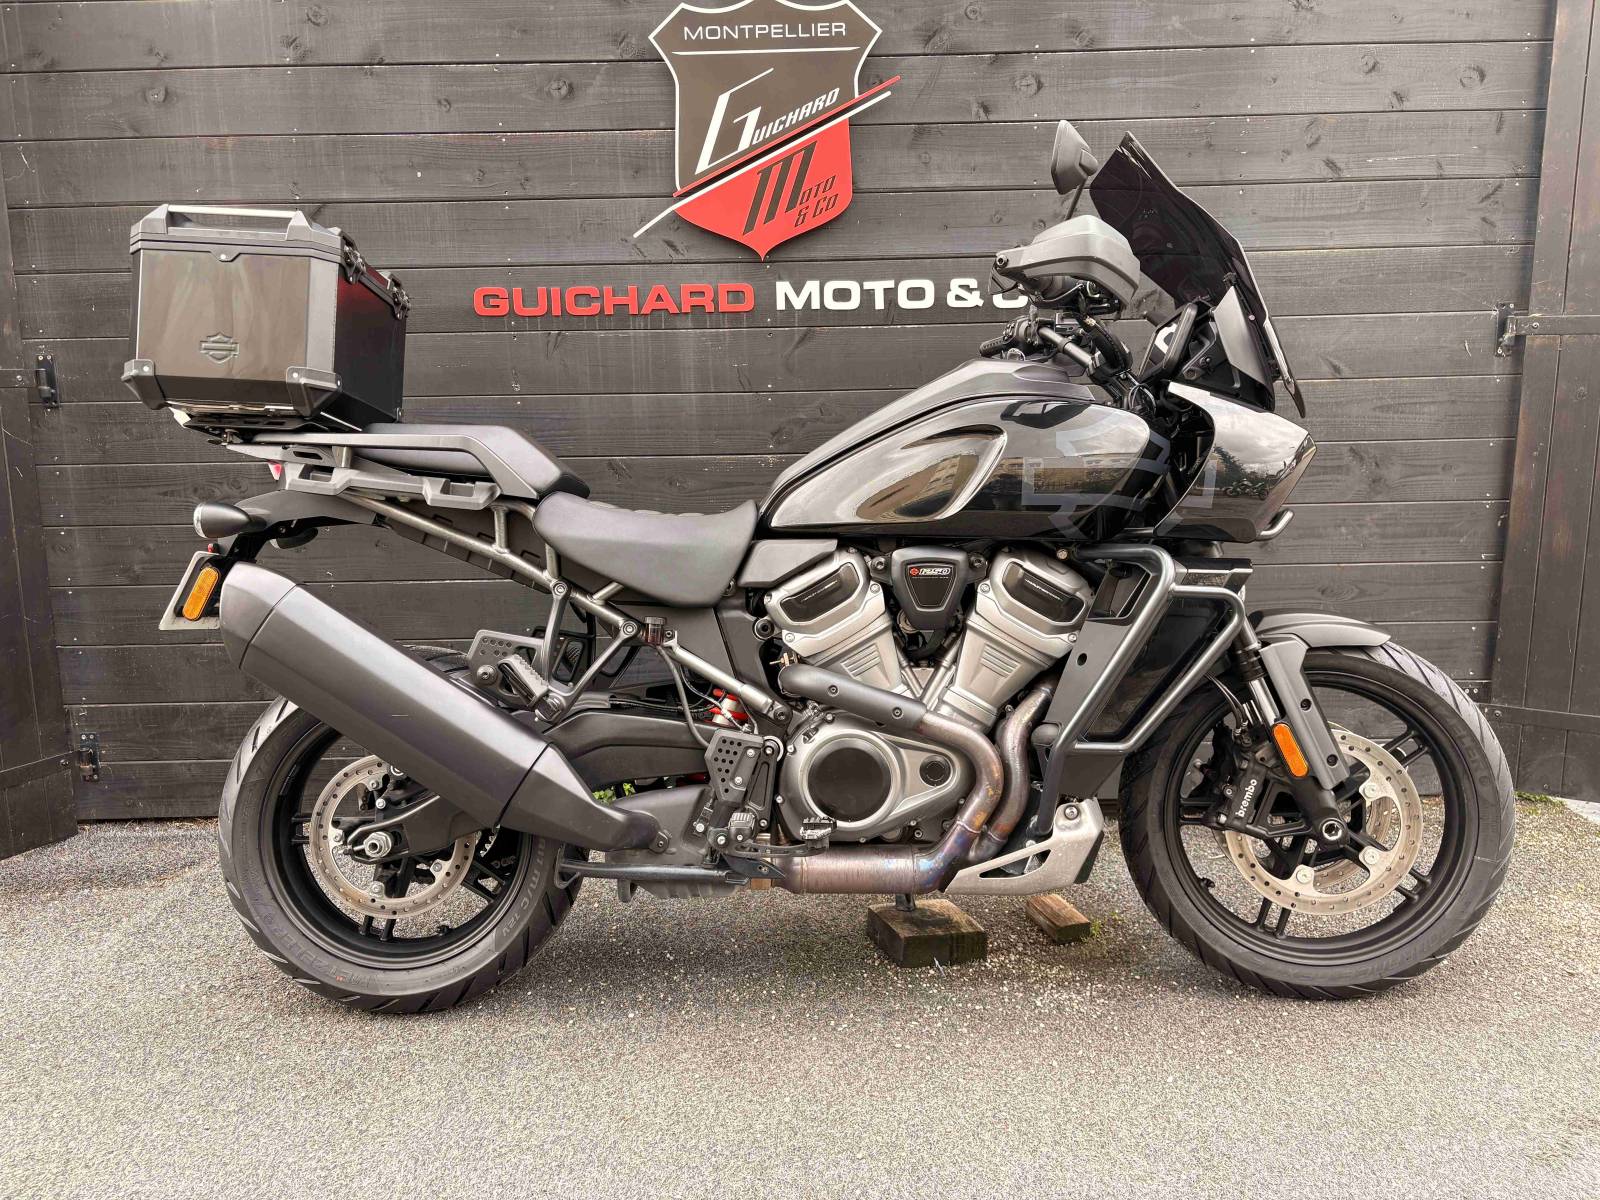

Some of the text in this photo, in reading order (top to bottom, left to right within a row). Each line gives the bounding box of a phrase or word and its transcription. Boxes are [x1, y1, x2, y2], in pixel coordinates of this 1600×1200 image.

[684, 22, 846, 41] MONTPELLIER
[473, 282, 755, 317] GUICHARD
[775, 278, 935, 311] MOTO
[946, 278, 985, 309] &
[1235, 779, 1258, 818] brembo
